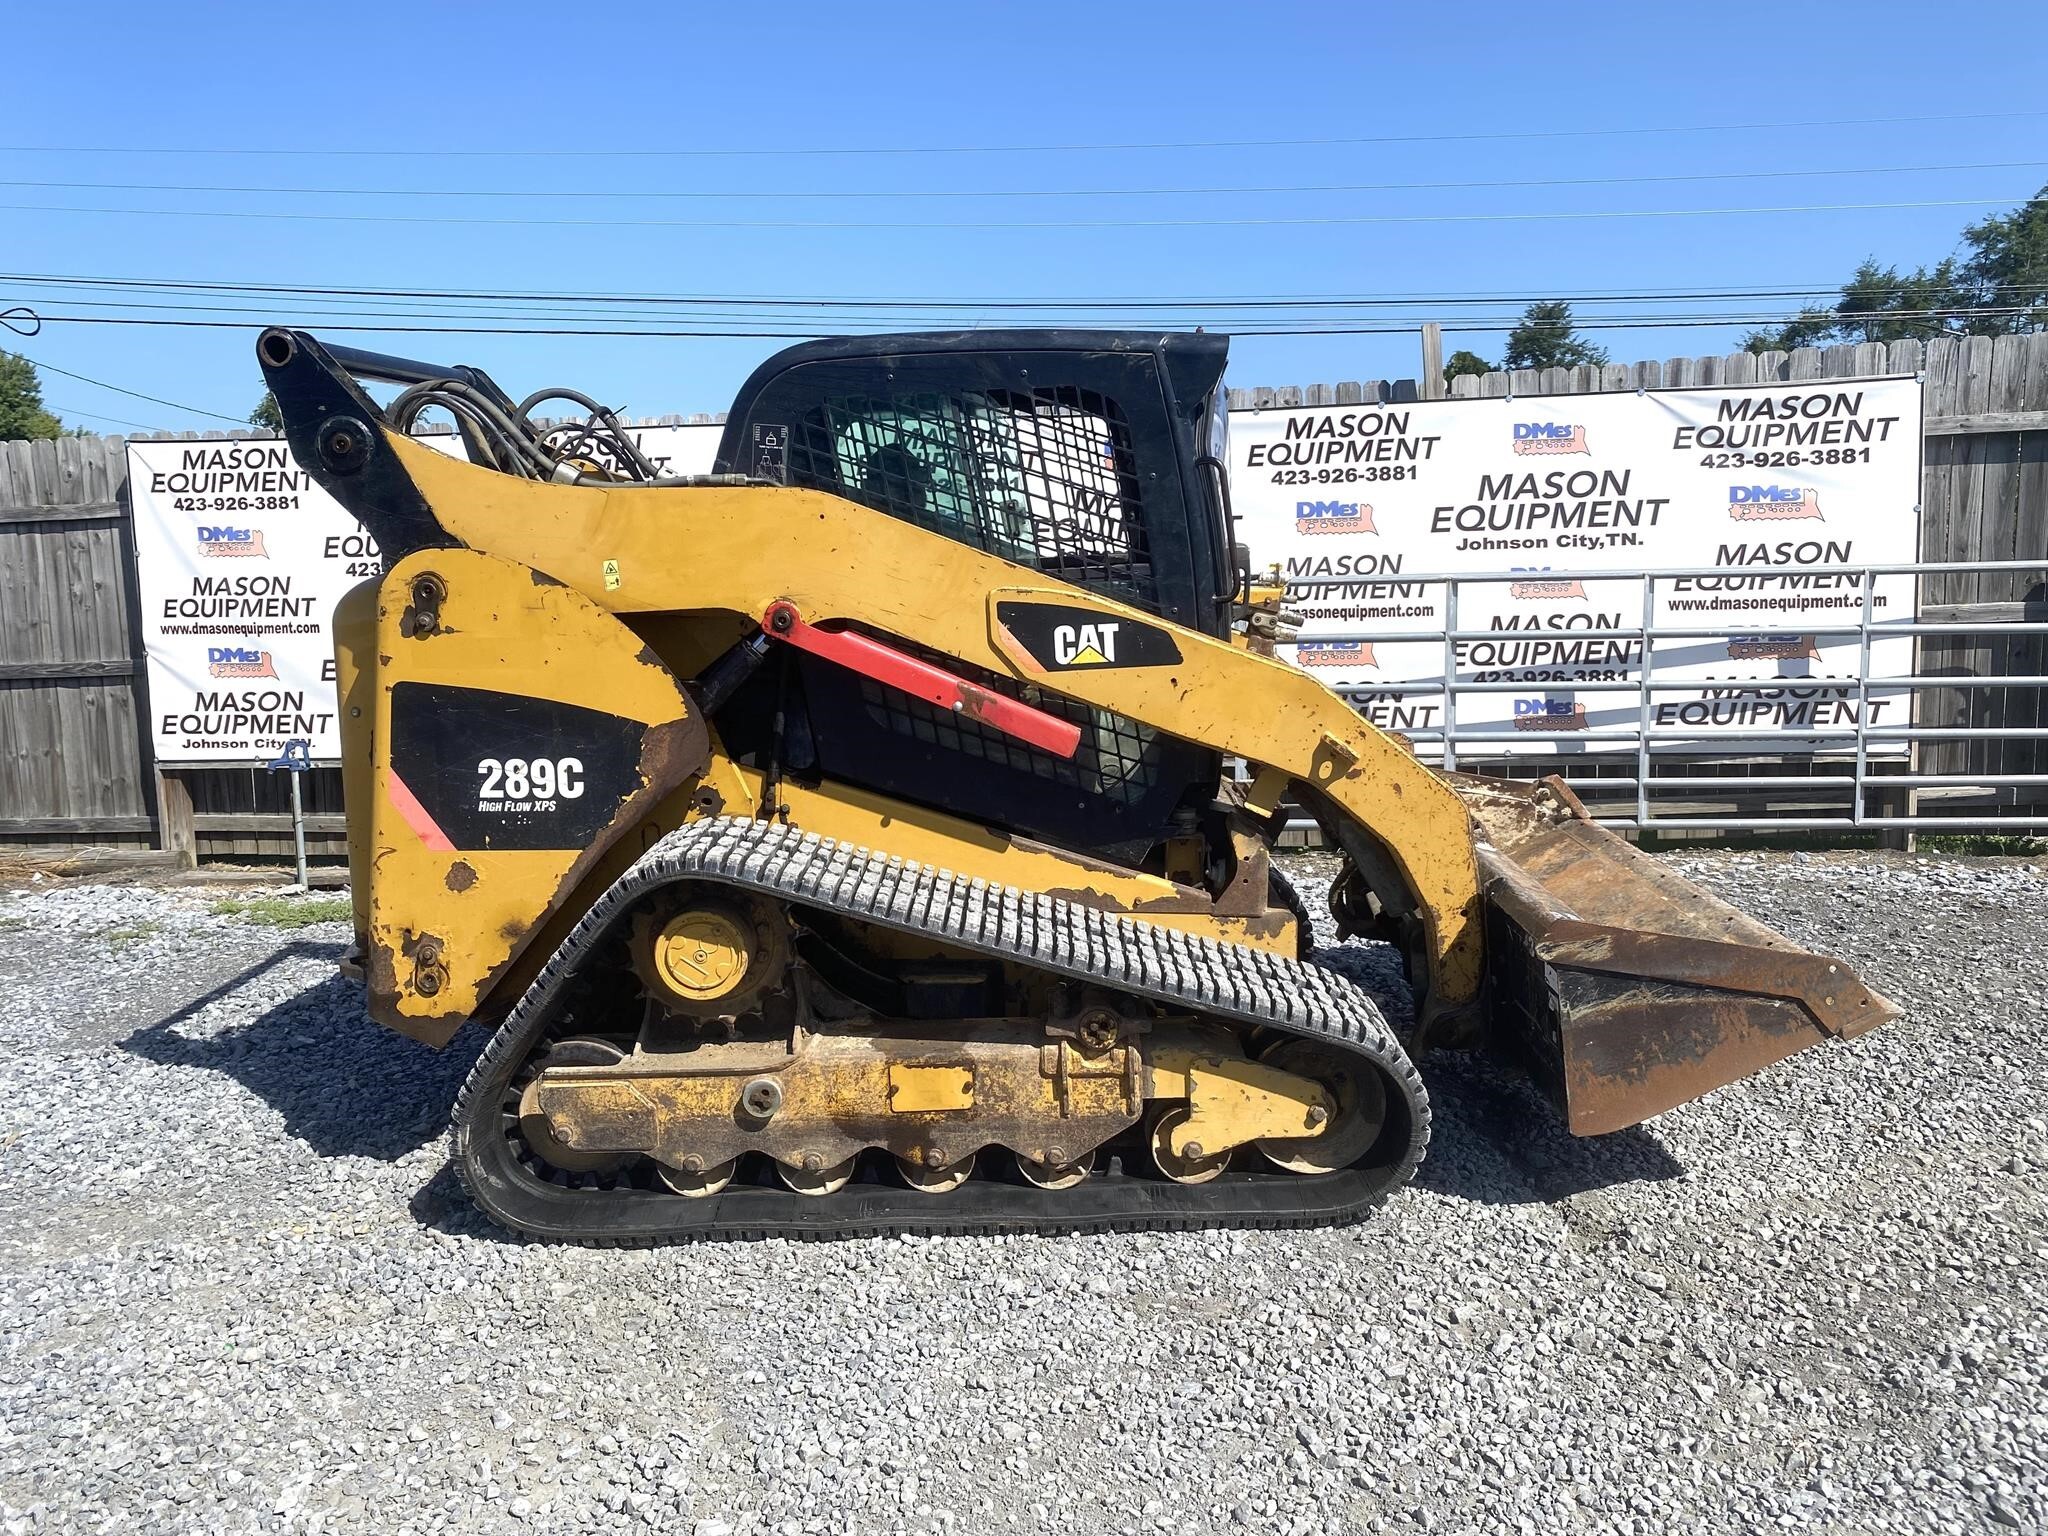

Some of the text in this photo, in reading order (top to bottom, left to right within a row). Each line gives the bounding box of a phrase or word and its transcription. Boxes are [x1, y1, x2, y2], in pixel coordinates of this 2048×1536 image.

[1717, 392, 1862, 422] MASON
[1285, 412, 1409, 440] MASON
[1673, 416, 1899, 450] EQUIPMENT
[182, 448, 287, 470] MASON
[1247, 436, 1441, 467] EQUIPMENT
[1700, 447, 1870, 469] 423-926-3881
[150, 470, 312, 493] EQUIPMENT
[1271, 465, 1417, 486] 423-926-3881
[1478, 469, 1631, 501] MASON
[173, 496, 300, 511] 423-926-3881
[1431, 499, 1670, 533] EQUIPMENT
[1456, 533, 1644, 551] Johnson City,TN.
[1715, 541, 1852, 566] MASON
[1286, 554, 1402, 576] MASON
[192, 576, 291, 596] MASON
[163, 597, 316, 618] EQUIPMENT
[1668, 594, 1887, 612] www.dmasonequipment.cm
[160, 622, 320, 638] www.dmasonequipment.com
[1053, 622, 1119, 665] CAT
[195, 691, 304, 711] MASON
[161, 714, 334, 734] EQUIPMENT
[1656, 700, 1890, 726] EQUIPMENT
[182, 738, 248, 749] Johnson
[477, 757, 585, 800] 289C
[533, 800, 557, 812] XPS
